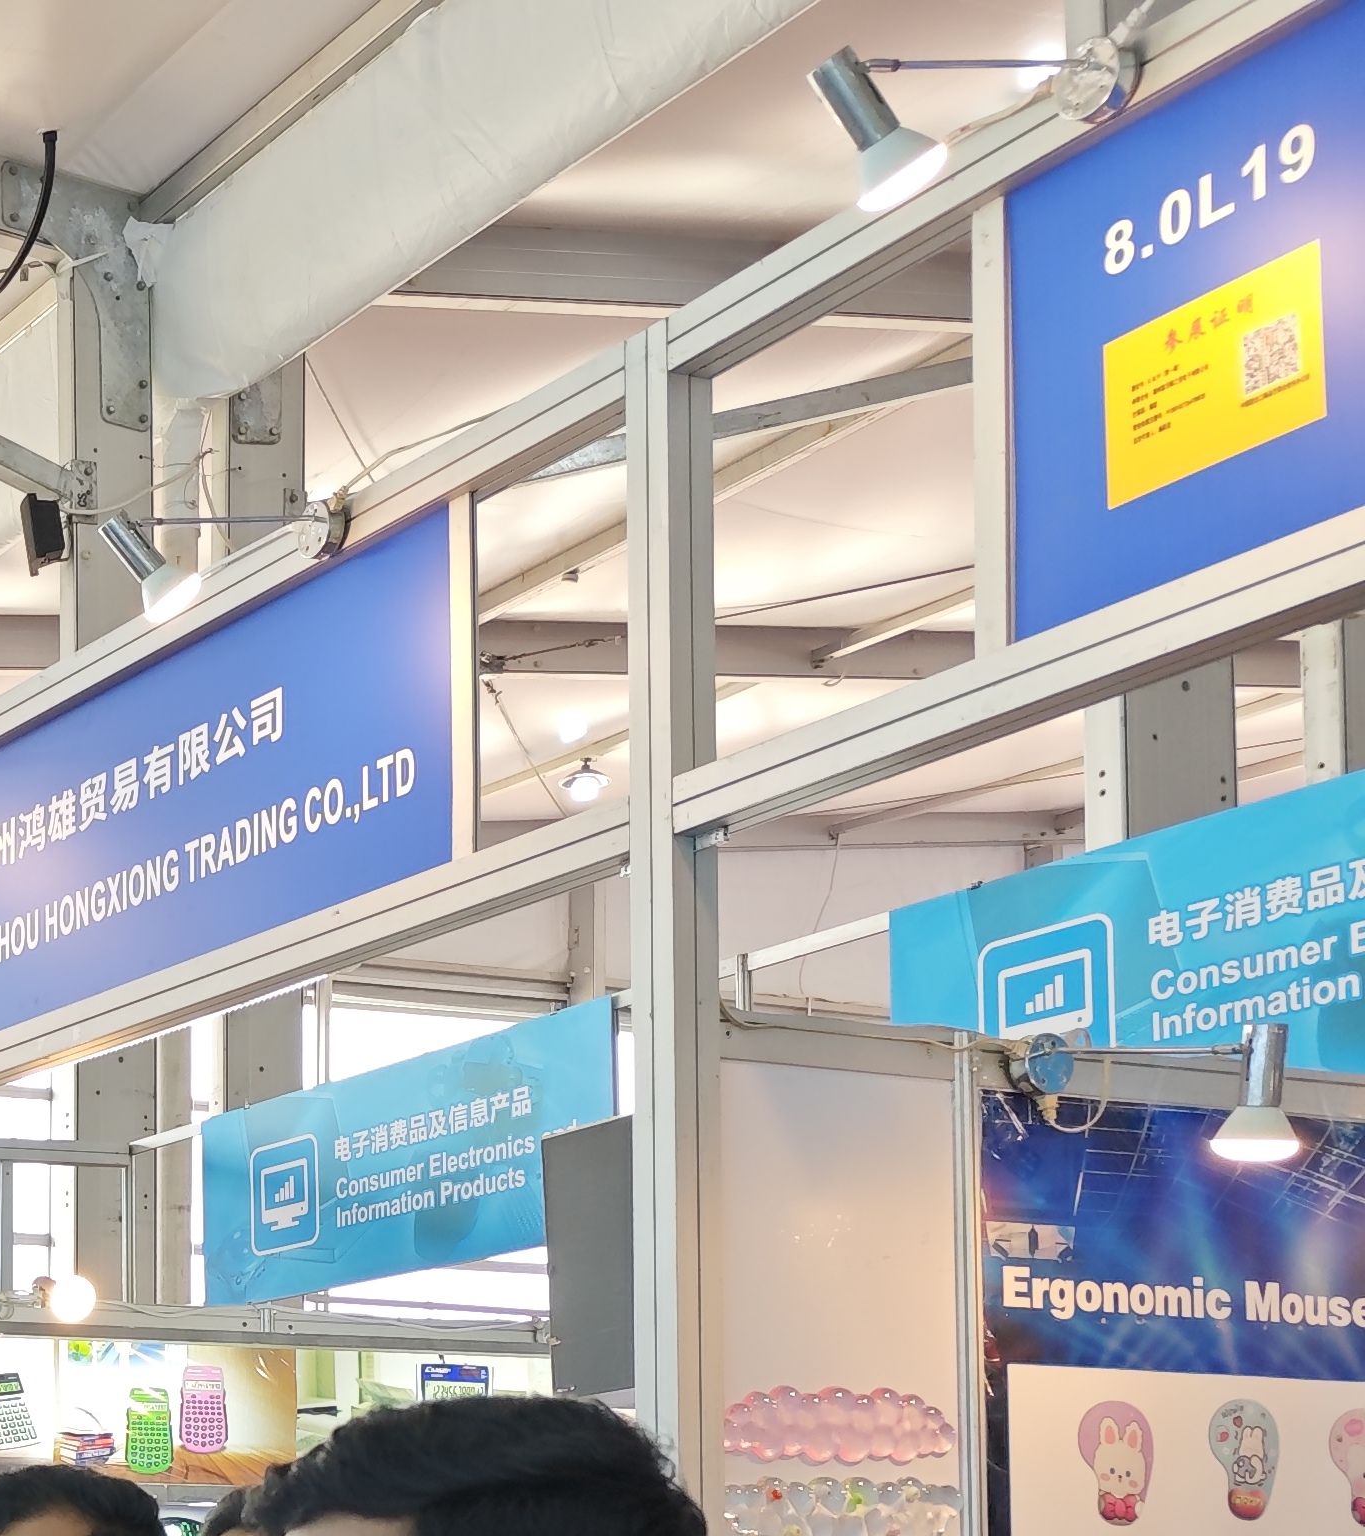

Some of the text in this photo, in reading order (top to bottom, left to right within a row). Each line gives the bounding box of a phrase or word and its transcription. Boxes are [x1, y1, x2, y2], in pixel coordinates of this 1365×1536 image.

[1103, 123, 1316, 276] 8.0L19
[45, 848, 179, 944] HONGXIONG
[184, 800, 298, 884] TRADING
[303, 746, 416, 833] CO.,LTD
[1149, 932, 1338, 1002] Consumer
[1151, 969, 1361, 1043] Information
[334, 1085, 532, 1162] 电子消费品及信息产品
[335, 1134, 536, 1200] Consumer Electronics
[335, 1166, 526, 1229] Information Products
[1002, 1265, 1365, 1328] Ergonomic Mouse
